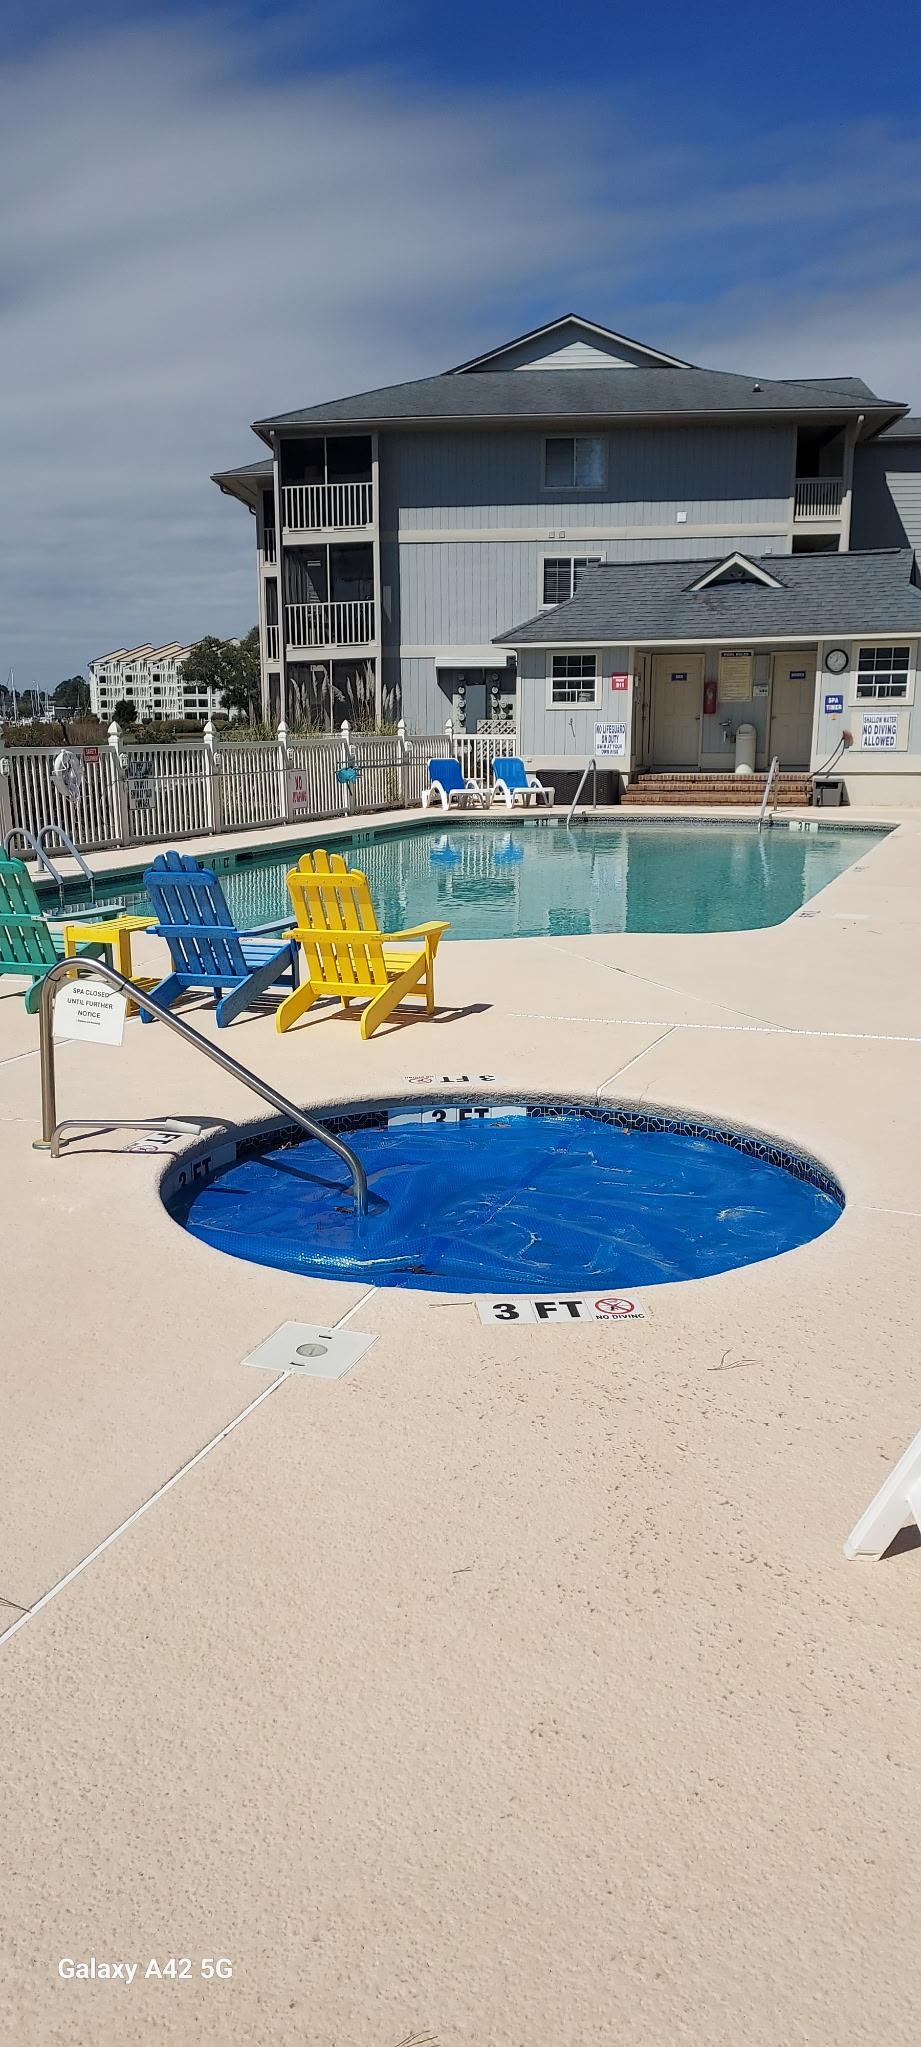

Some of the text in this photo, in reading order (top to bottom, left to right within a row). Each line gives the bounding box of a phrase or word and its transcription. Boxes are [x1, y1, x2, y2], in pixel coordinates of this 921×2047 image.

[597, 725, 625, 734] NO LIFEGUARD
[863, 725, 897, 735] NO DIVING
[602, 735, 619, 743] ON DUTY
[864, 736, 895, 746] ALLOWED
[86, 1001, 113, 1009] FURTHER
[78, 1010, 101, 1018] NOTICE
[460, 1108, 489, 1122] FT
[493, 1303, 520, 1320] 3
[535, 1301, 583, 1319] FT
